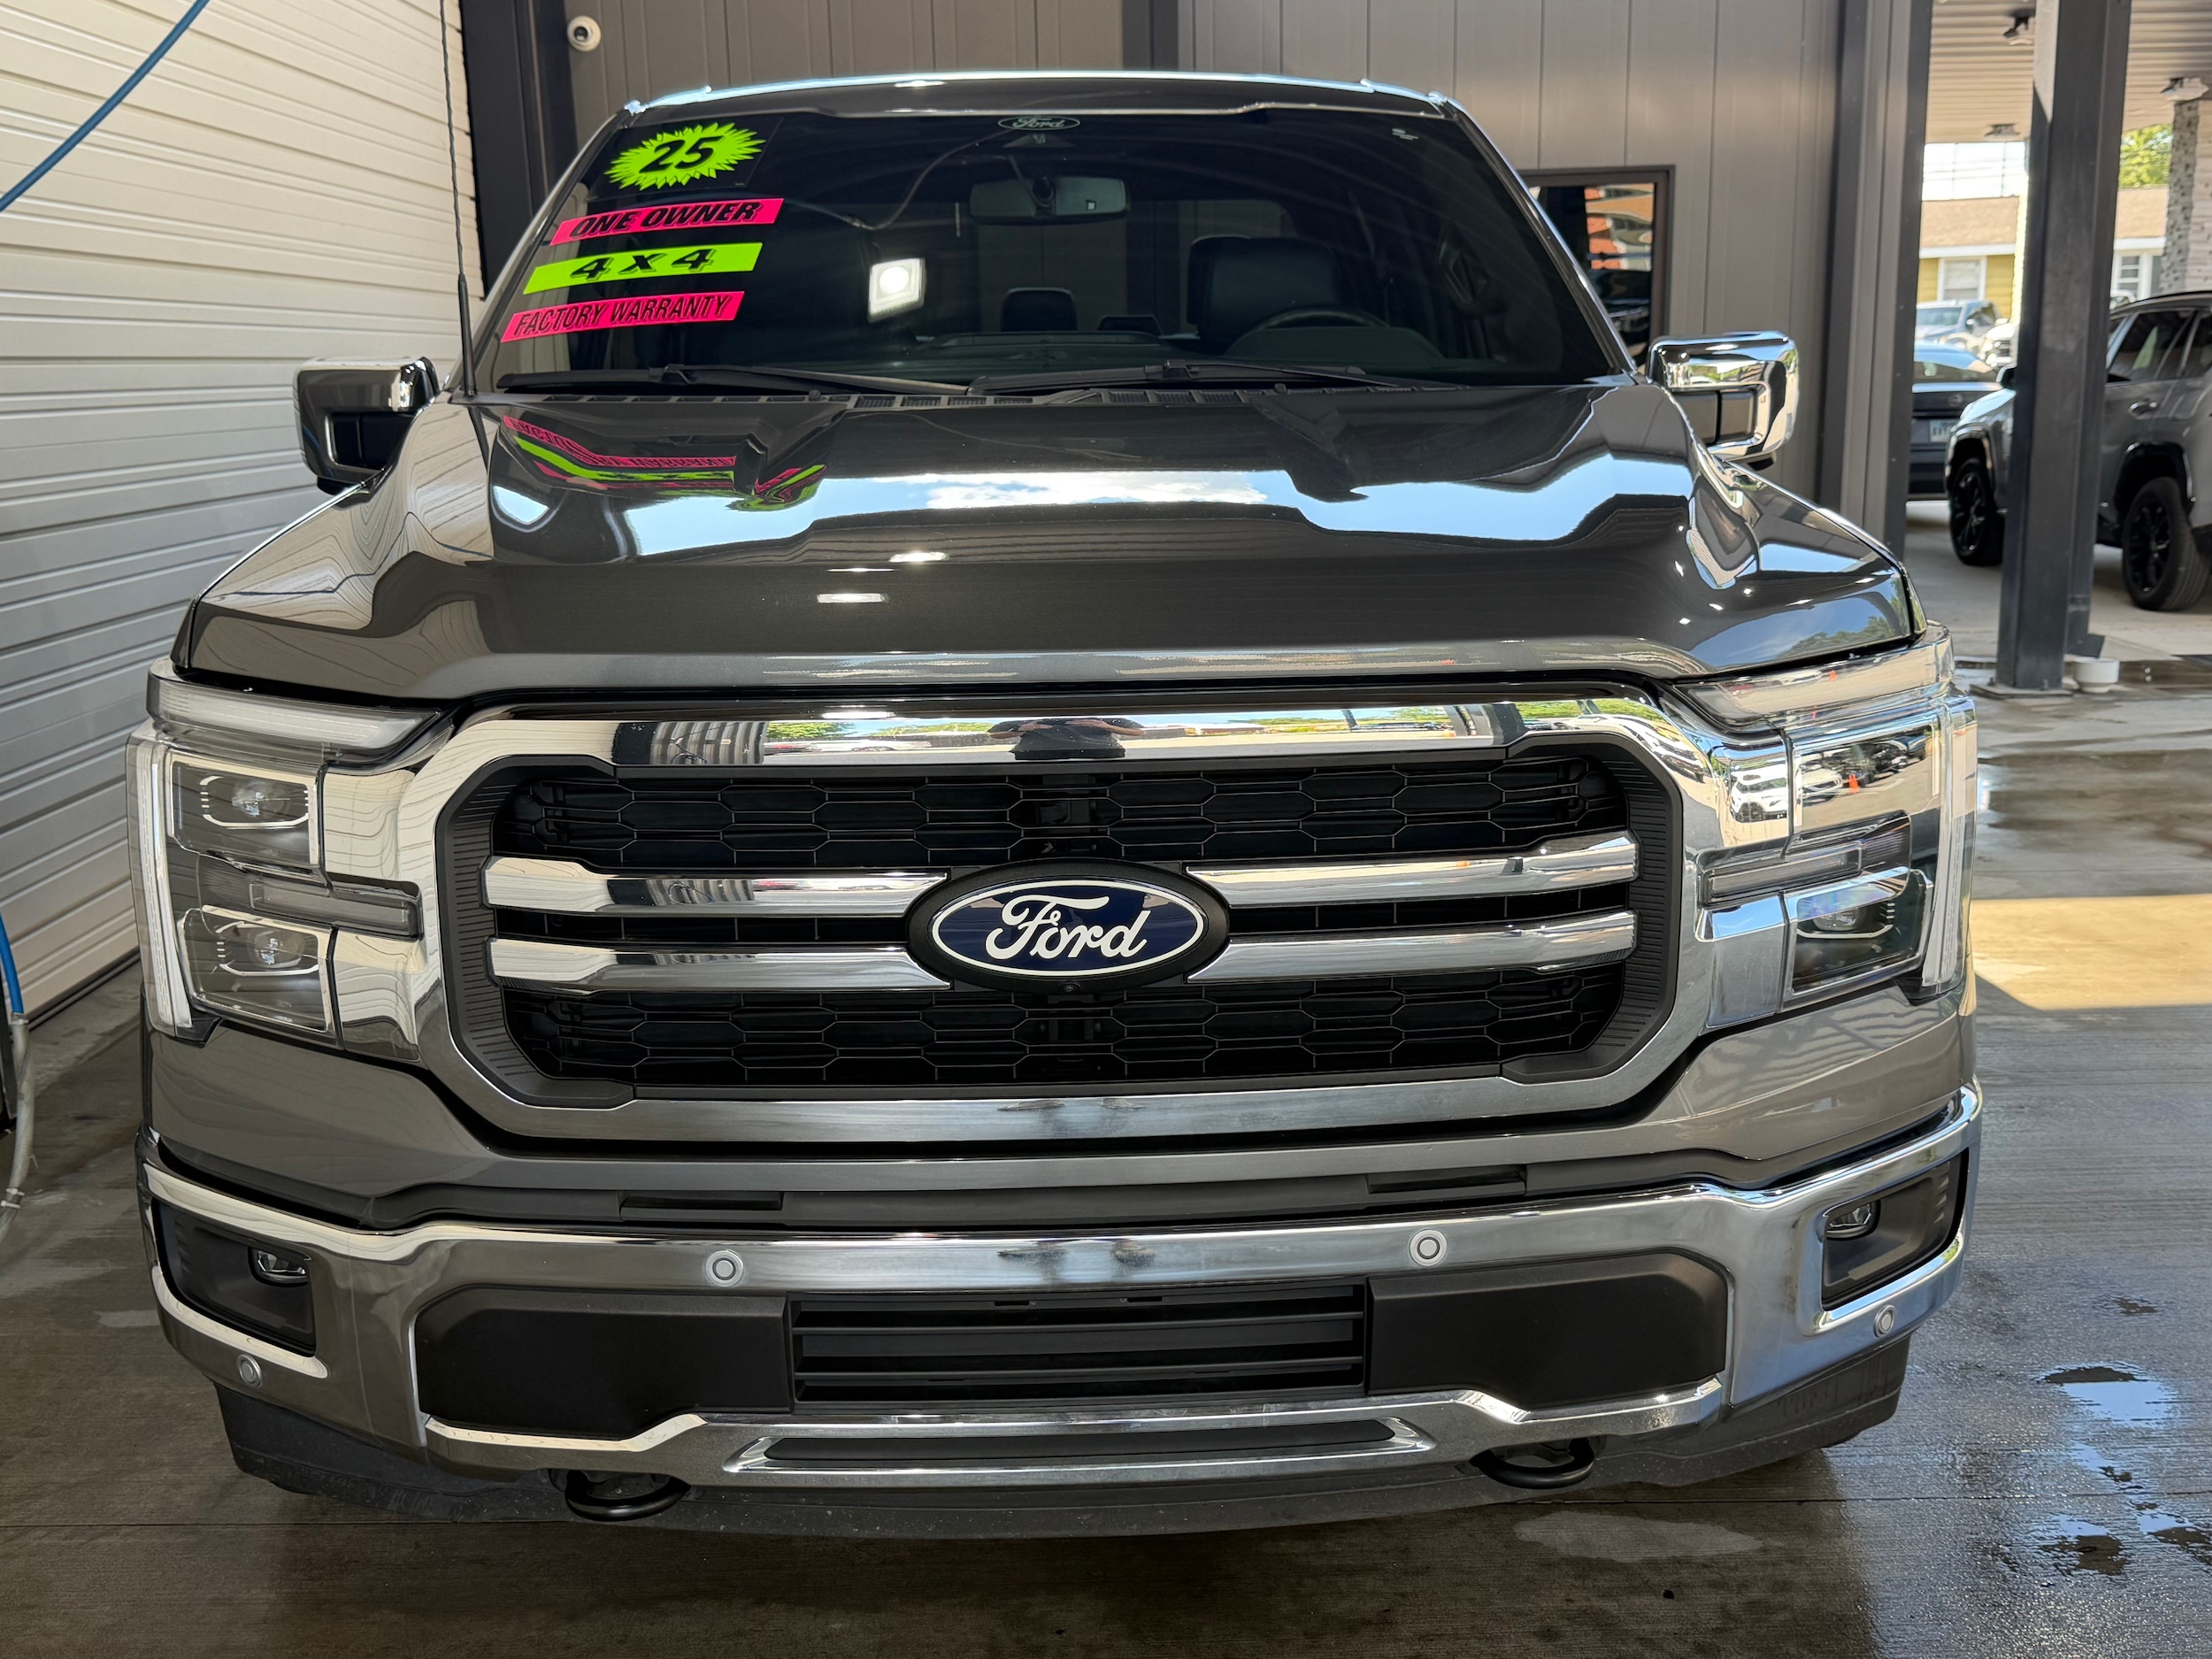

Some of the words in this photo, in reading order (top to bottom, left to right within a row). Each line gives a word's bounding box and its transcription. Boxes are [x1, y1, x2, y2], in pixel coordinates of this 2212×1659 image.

[1012, 118, 1066, 128] Ford
[639, 134, 725, 174] 25
[569, 210, 638, 240] ONE
[643, 201, 765, 228] OWNER
[570, 257, 614, 281] 4
[671, 248, 717, 271] 4
[512, 303, 609, 336] FACTORY
[609, 294, 731, 324] WARRANTY
[985, 894, 1152, 959] Ford
